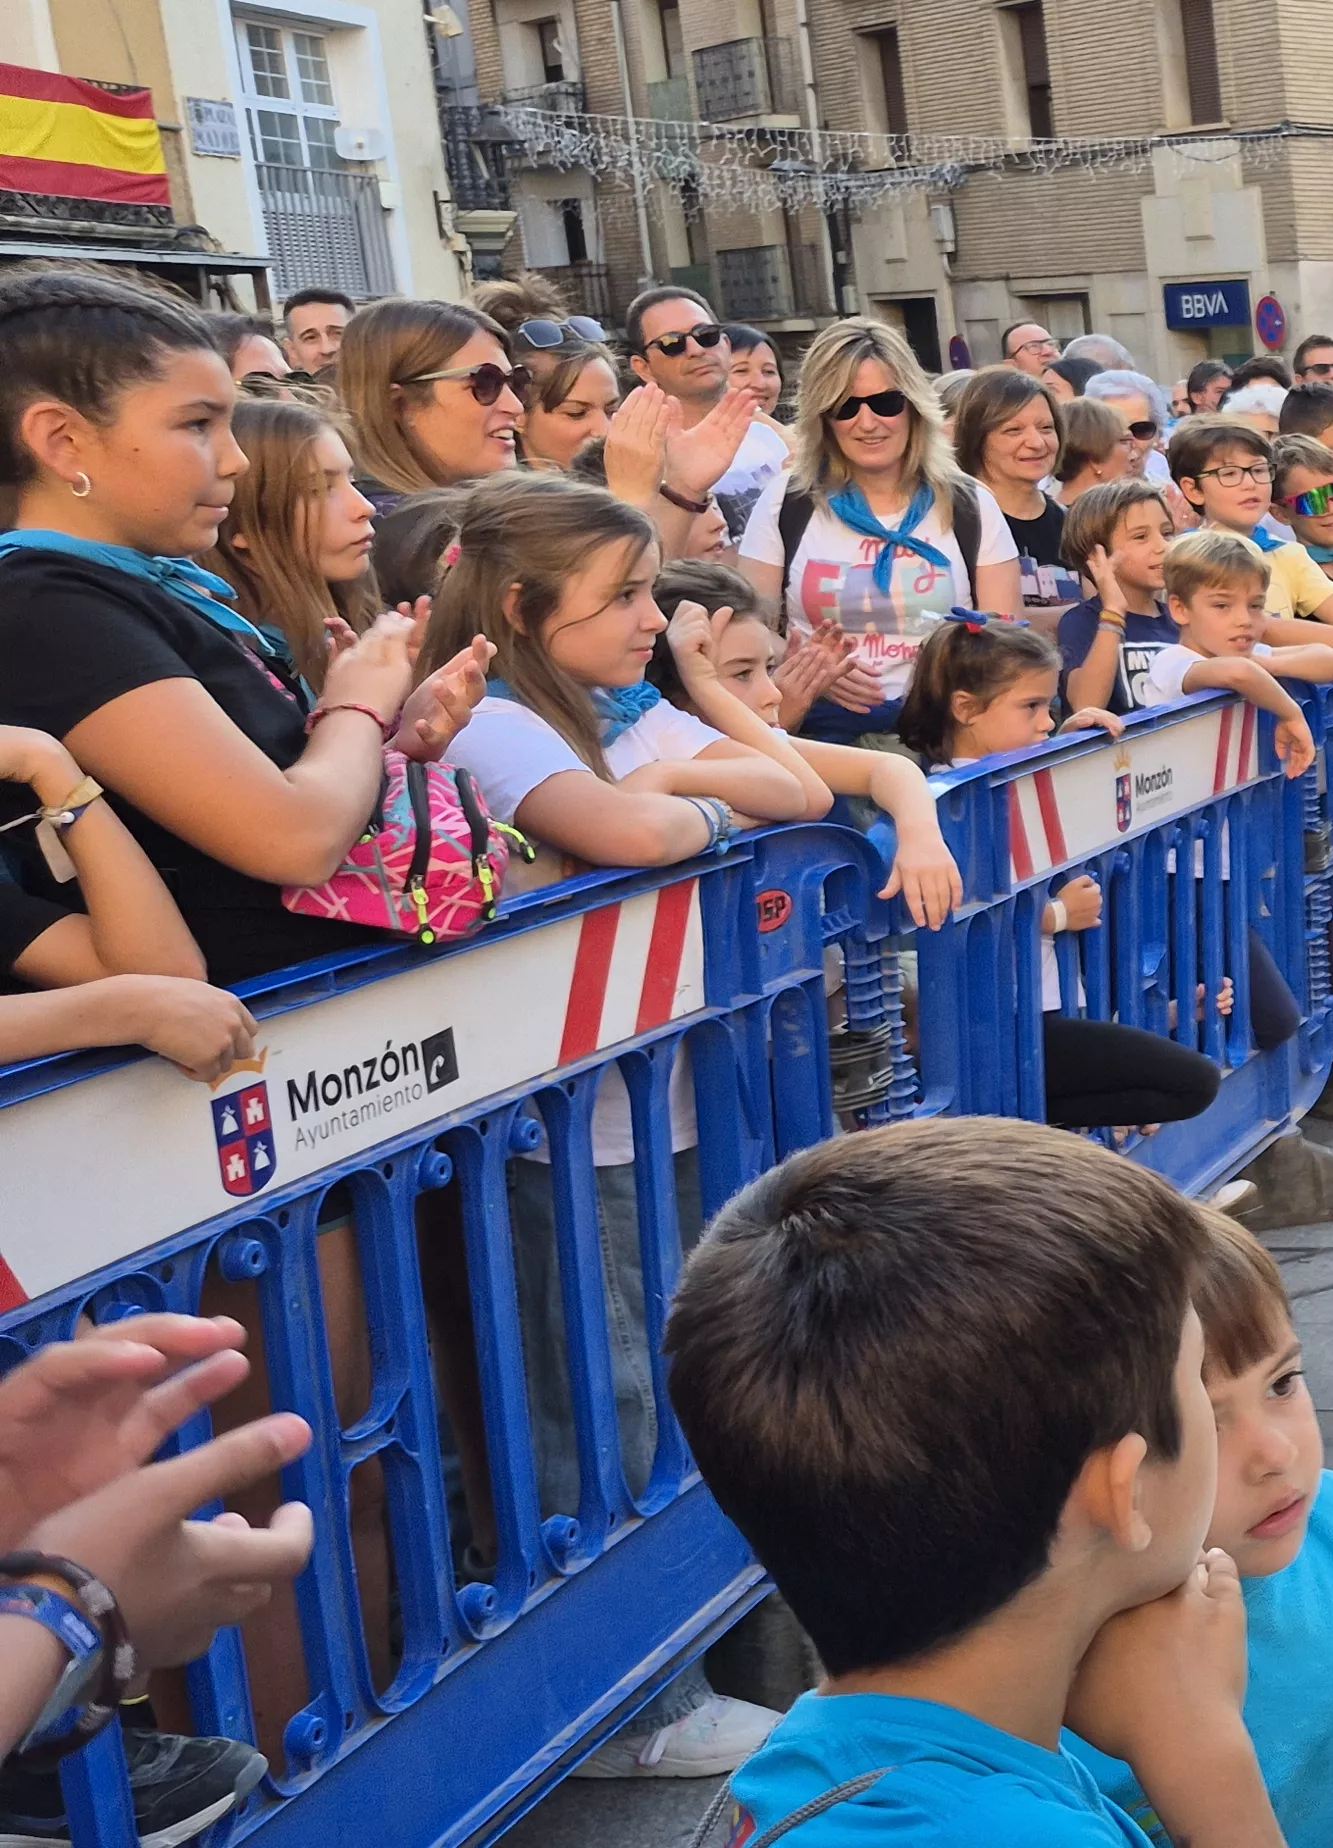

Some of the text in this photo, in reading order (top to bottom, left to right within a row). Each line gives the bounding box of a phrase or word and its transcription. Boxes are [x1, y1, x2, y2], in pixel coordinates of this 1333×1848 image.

[1181, 291, 1229, 318] BBVA
[1136, 764, 1173, 798] Monzón
[287, 1040, 420, 1121] Monzón
[295, 1083, 424, 1152] Ayuntamiento
